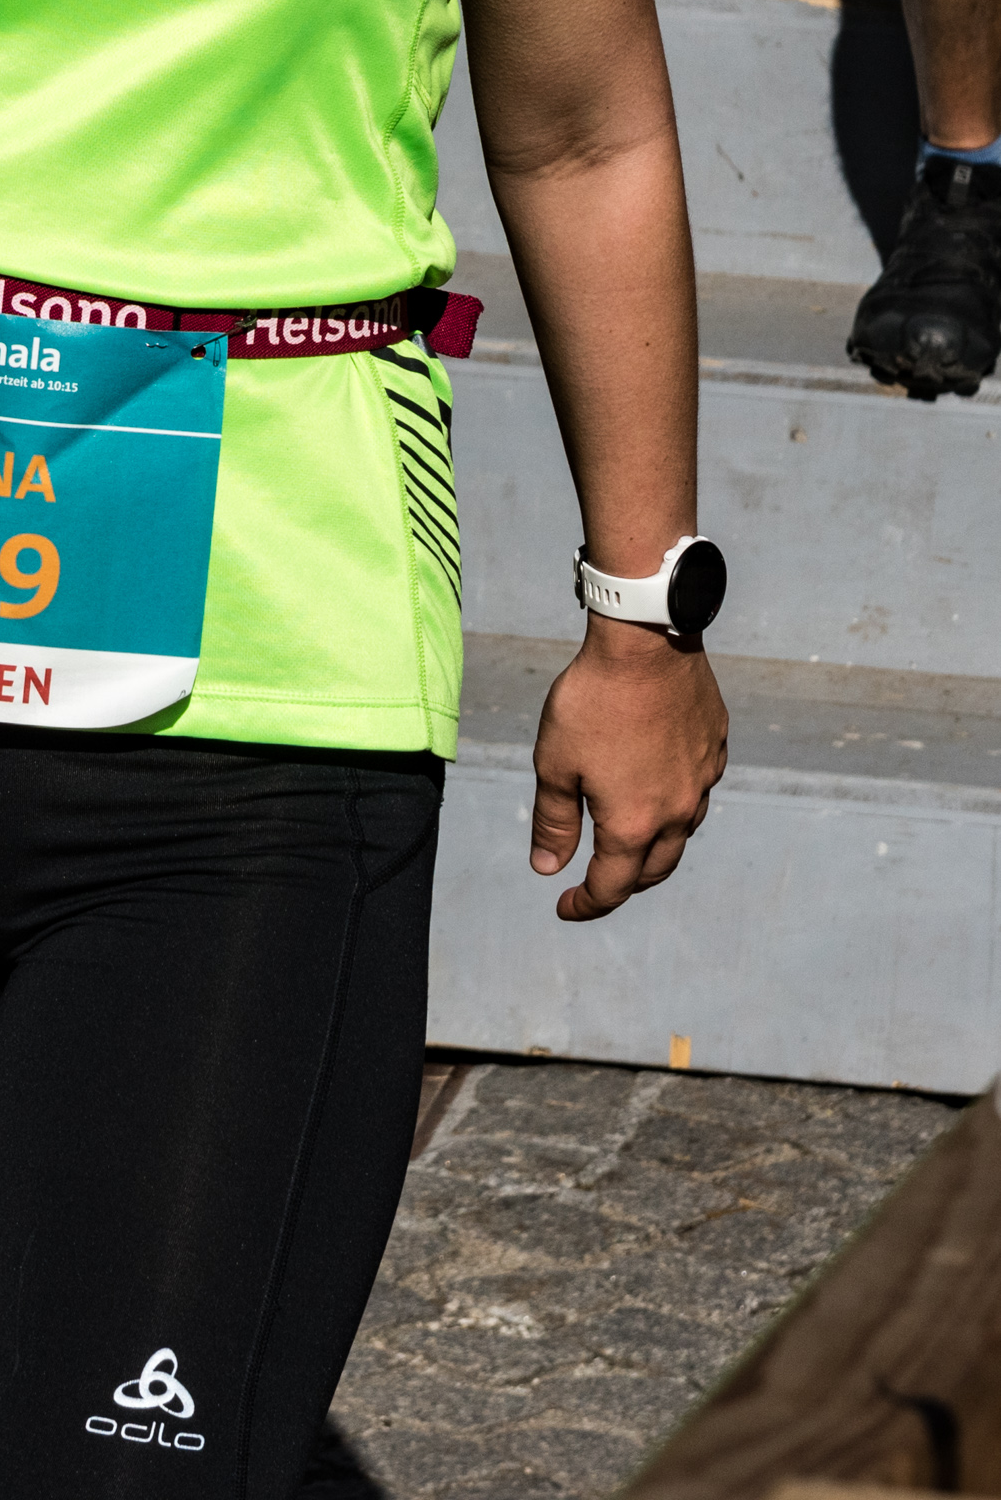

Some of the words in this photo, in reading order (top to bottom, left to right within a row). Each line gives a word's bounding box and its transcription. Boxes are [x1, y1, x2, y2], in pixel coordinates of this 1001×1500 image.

[30, 378, 45, 390] ab
[47, 380, 78, 392] 10:15
[85, 1416, 205, 1450] odlo
